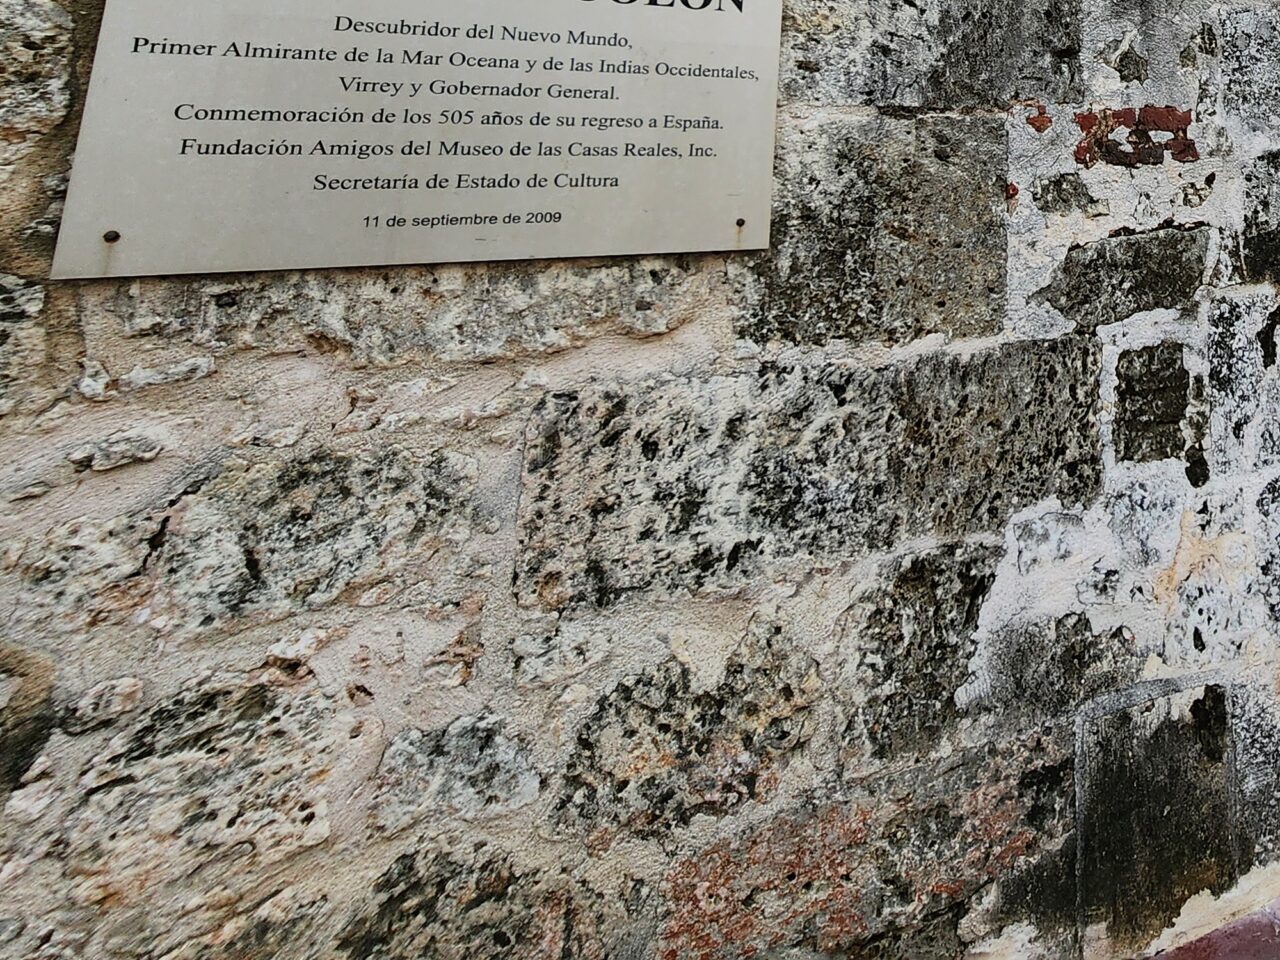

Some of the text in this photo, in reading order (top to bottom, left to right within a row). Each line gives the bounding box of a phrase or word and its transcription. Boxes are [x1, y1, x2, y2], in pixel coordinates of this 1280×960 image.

[334, 16, 632, 49] Descubridor del Nuevo Mundo,
[131, 37, 758, 81] Primer Almirante de la Mar Oceana y de las Indias Occidentales,
[339, 77, 619, 100] Virrey y Gobernador General.
[174, 104, 723, 132] Conmemoración de los 505 años de su regreso a España.
[179, 139, 717, 159] Fundación Amigos del Museo de las Casas Reales, Inc.
[313, 173, 619, 190] Secretaría de Estado de Cultura
[363, 212, 562, 229] 11 de septiembre de 2009
